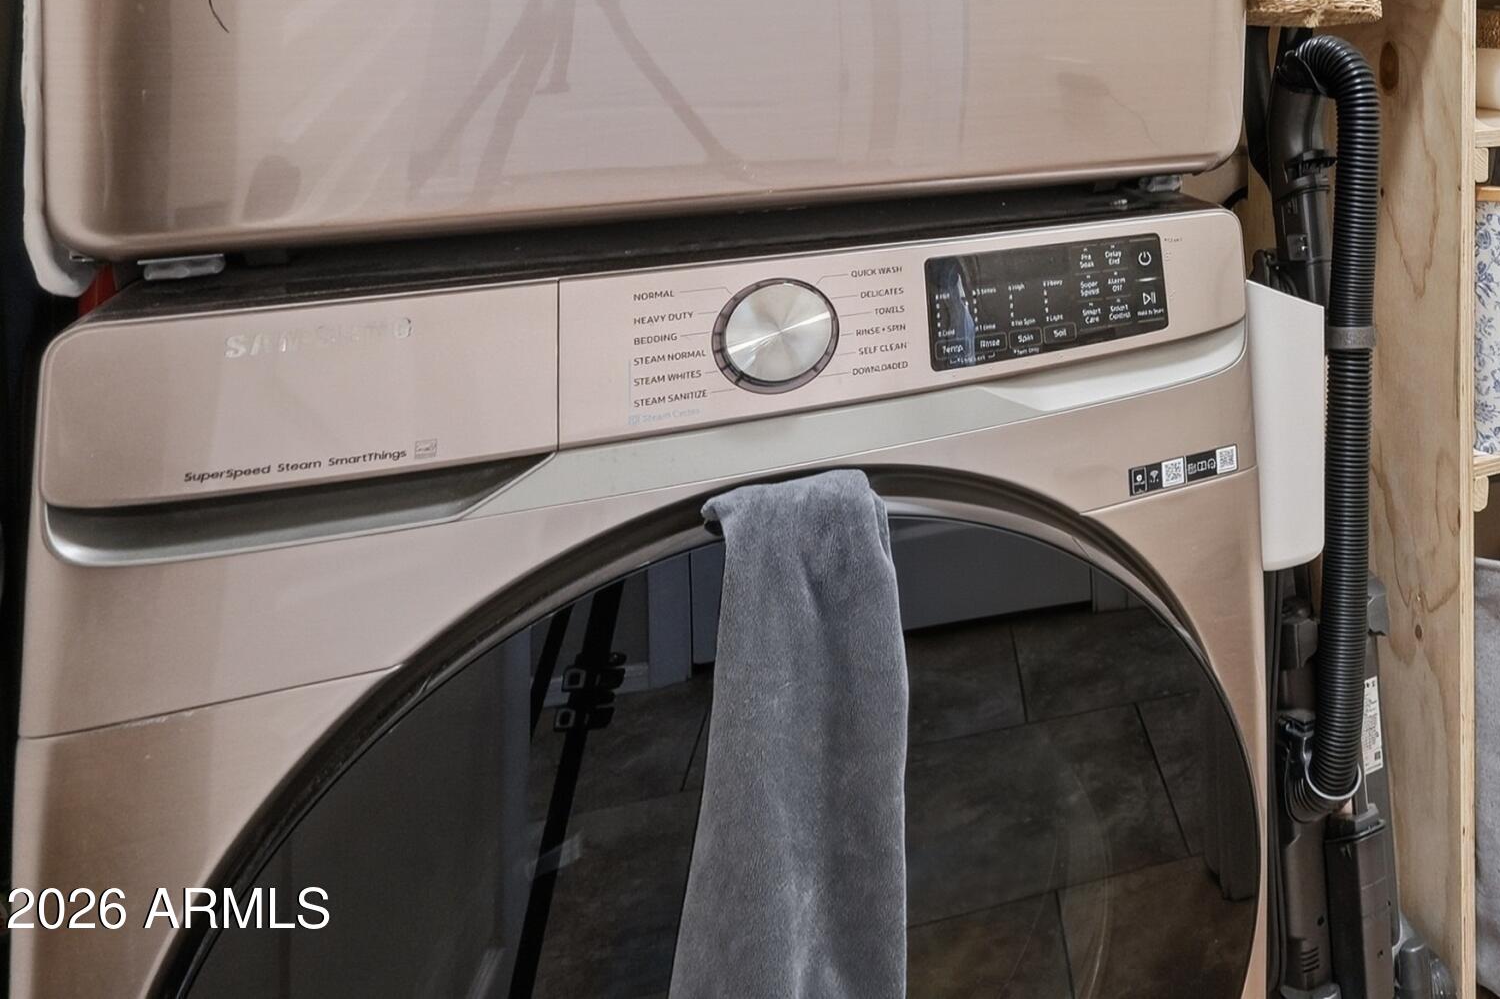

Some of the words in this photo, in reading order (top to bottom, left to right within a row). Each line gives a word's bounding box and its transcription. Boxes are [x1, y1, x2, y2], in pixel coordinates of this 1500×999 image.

[851, 268, 877, 278] QUICK
[878, 266, 903, 275] WASH
[1080, 281, 1098, 290] Super
[1107, 277, 1126, 285] Alarm
[633, 290, 675, 301] NORMAL
[860, 287, 904, 299] DELICATES
[874, 305, 905, 315] TOWELS
[1082, 308, 1101, 316] Smart
[633, 314, 666, 325] HEAVY
[668, 311, 694, 321] DUTY
[856, 326, 880, 336] RINSE
[887, 323, 906, 332] SPIN
[1053, 328, 1067, 338] Soil
[633, 332, 678, 346] BEDDING
[1018, 334, 1034, 343] Spin
[858, 345, 878, 355] SELF
[879, 342, 907, 352] CLEAN
[942, 344, 964, 355] Temp
[633, 354, 666, 366] STEAM
[667, 350, 707, 361] NORMAL
[852, 361, 909, 376] DOWNLOADED
[633, 375, 666, 387] STEAM
[667, 370, 702, 382] WHITES
[633, 395, 666, 408] STEAM
[667, 389, 708, 403] SANITIZE
[184, 464, 271, 483] SuperSpeed
[277, 459, 322, 473] Steam
[328, 448, 407, 467] SmartThings
